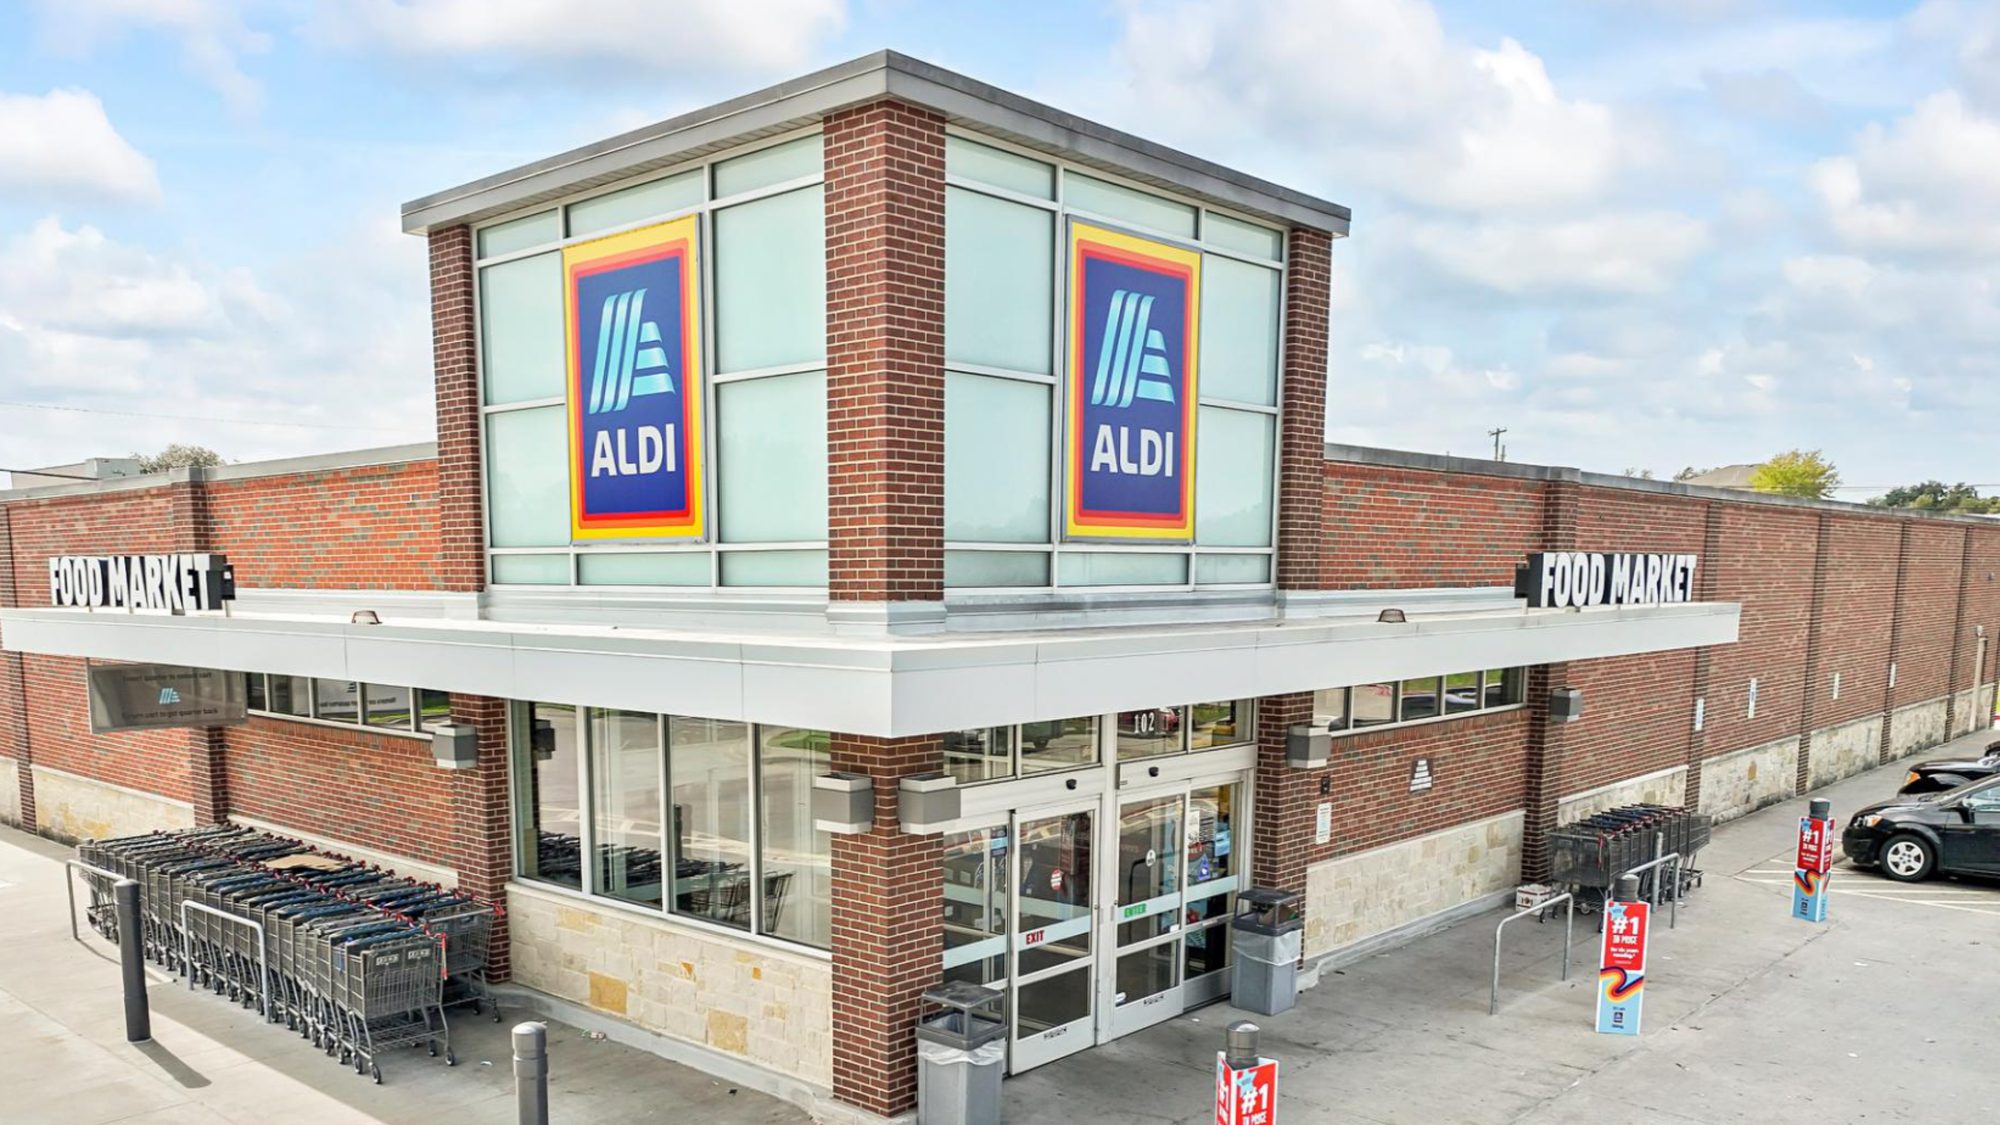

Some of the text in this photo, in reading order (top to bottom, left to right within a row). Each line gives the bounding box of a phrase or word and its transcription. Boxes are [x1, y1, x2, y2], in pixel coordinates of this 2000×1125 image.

[591, 423, 676, 477] ALDI
[1090, 424, 1173, 477] ALDI
[49, 553, 210, 610] FOOD MARKET
[1540, 552, 1697, 608] FOOD MARKET
[1134, 712, 1155, 734] 102
[1802, 830, 1819, 845] #1
[1026, 930, 1044, 945] EXIT
[1612, 917, 1639, 935] #1
[1241, 1083, 1269, 1115] #1
